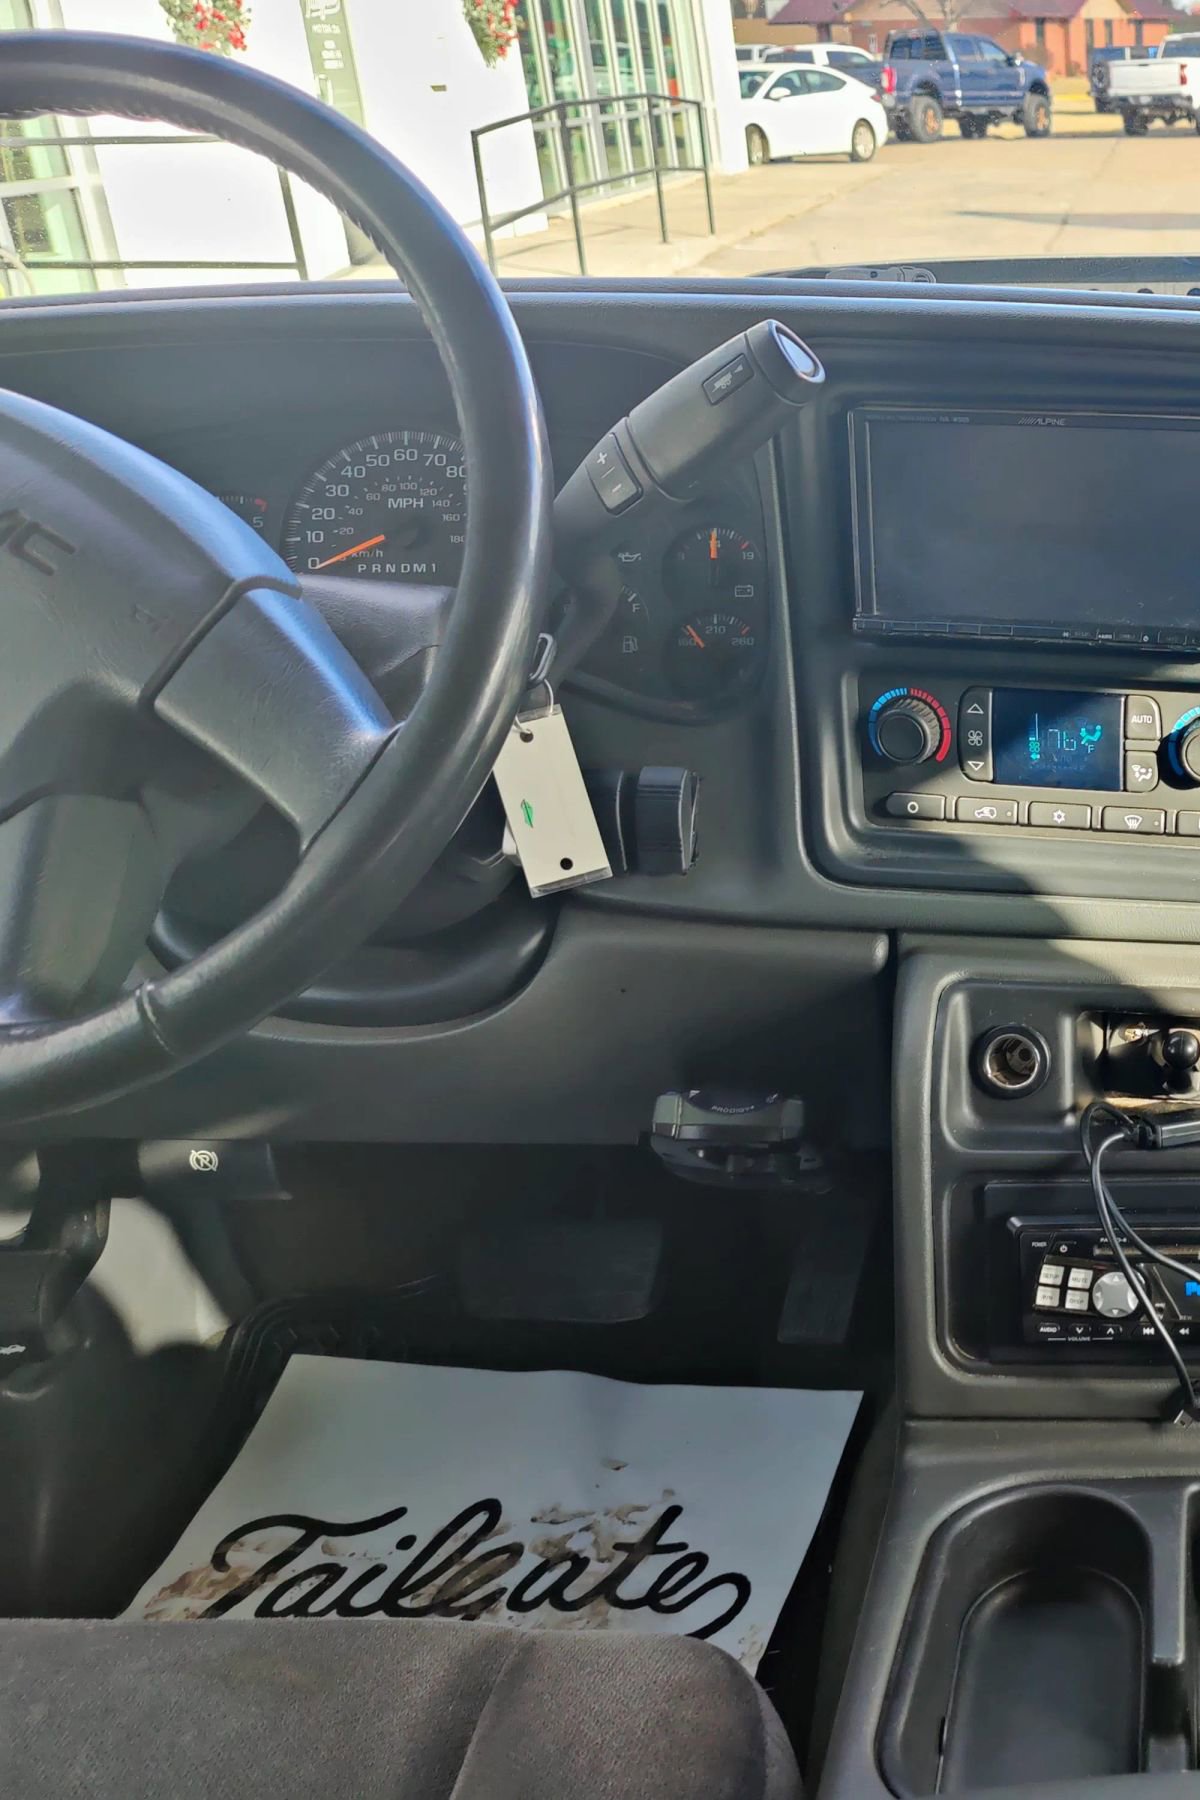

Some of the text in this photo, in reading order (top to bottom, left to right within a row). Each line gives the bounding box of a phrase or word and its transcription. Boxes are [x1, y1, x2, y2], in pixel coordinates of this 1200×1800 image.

[1034, 418, 1066, 426] ALPINE
[394, 449, 417, 461] 60
[366, 454, 390, 466] 50
[423, 454, 446, 466] 70
[341, 466, 366, 478] 40
[325, 484, 350, 496] 30
[381, 484, 396, 492] 80
[400, 483, 417, 491] 100
[420, 488, 437, 496] 120
[366, 493, 381, 501] 60
[388, 498, 424, 508] MPH
[432, 499, 450, 507] 140
[311, 507, 336, 520] 20
[348, 508, 363, 516] 40
[442, 513, 460, 522] 160
[252, 517, 264, 528] 5
[339, 527, 354, 535] 20
[306, 530, 324, 543] 10
[351, 549, 383, 558] km/h
[742, 551, 754, 560] 19
[307, 557, 320, 569] 0
[632, 603, 641, 613] F
[705, 625, 726, 634] 210
[731, 636, 755, 646] 260
[1131, 714, 1153, 724] AUTO
[1031, 1240, 1048, 1248] POWER
